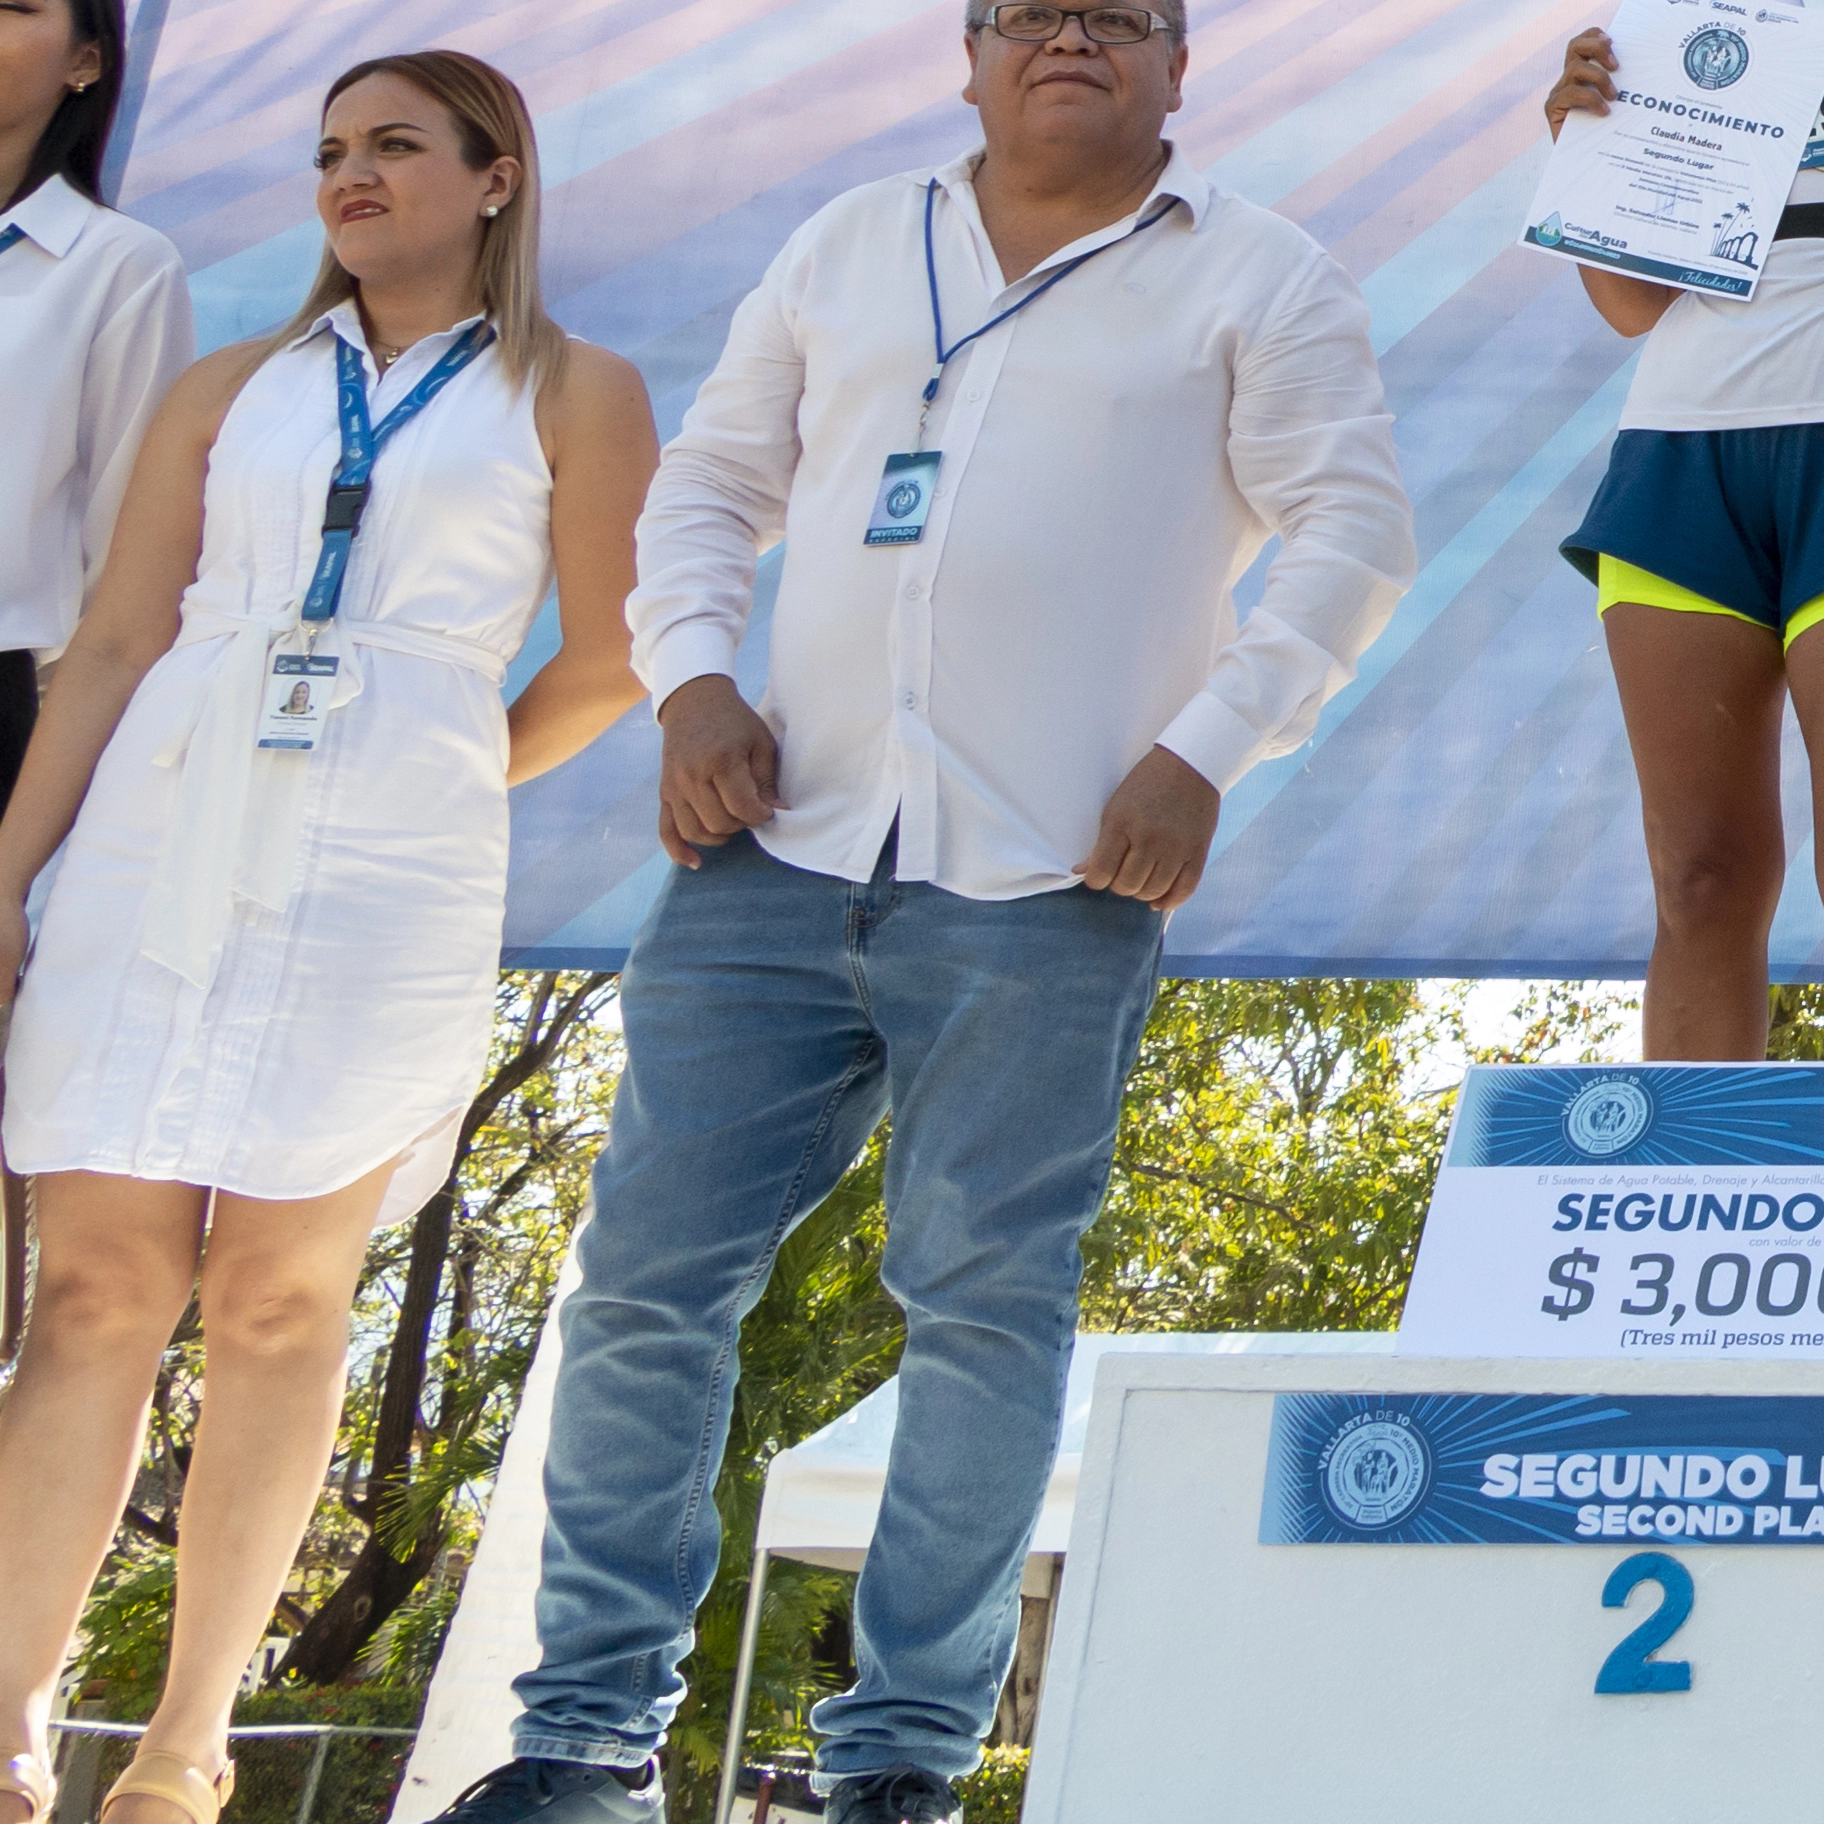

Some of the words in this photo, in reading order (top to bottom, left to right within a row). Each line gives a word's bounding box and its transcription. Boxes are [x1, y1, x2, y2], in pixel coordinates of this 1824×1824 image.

[1712, 1, 1748, 17] SEAPAL
[1616, 90, 1785, 139] ECONOCIMIENTO
[1650, 126, 1686, 143] Claudia
[1687, 135, 1723, 152] Madera
[1643, 147, 1685, 164] Segundo
[1686, 158, 1715, 171] Lugar
[1550, 1176, 1596, 1186] Sistema
[1598, 1176, 1613, 1186] de
[1616, 1176, 1649, 1189] Agua
[1652, 1176, 1697, 1188] Potable,
[1702, 1175, 1748, 1189] Drenaje
[1749, 1237, 1771, 1247] con
[1773, 1236, 1804, 1247] valor
[1806, 1236, 1822, 1247] de
[1541, 1247, 1601, 1321] $
[1620, 1329, 1676, 1349] (Tres
[1680, 1329, 1717, 1347] mil
[1721, 1332, 1786, 1350] pesos
[1316, 1411, 1374, 1471] VALLARTA
[1374, 1409, 1395, 1422] DE
[1396, 1412, 1412, 1427] 10
[1478, 1454, 1771, 1500] SEGUNDO
[1574, 1505, 1744, 1537] SECOND
[1594, 1552, 1696, 1695] 2
